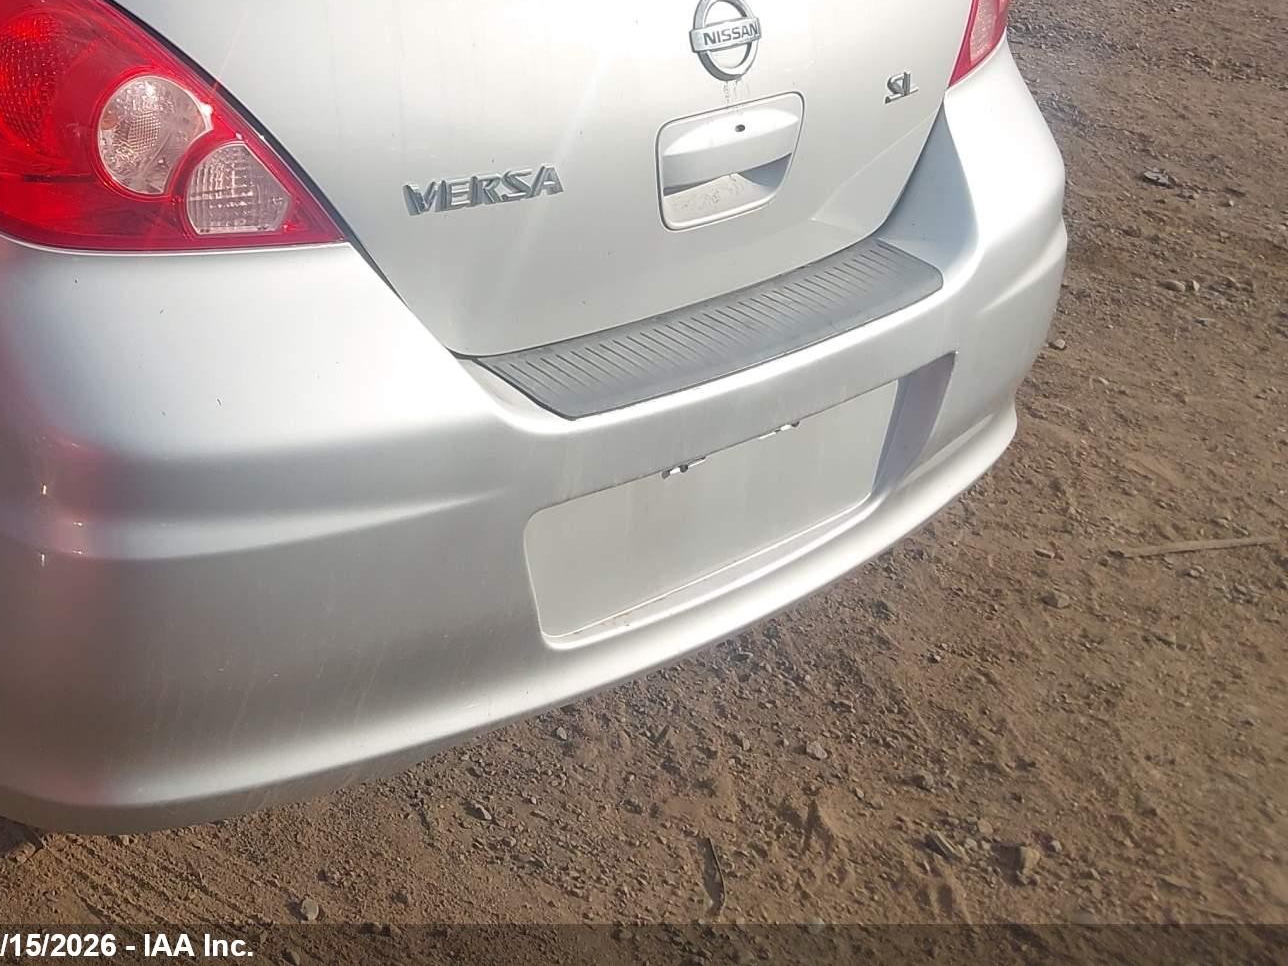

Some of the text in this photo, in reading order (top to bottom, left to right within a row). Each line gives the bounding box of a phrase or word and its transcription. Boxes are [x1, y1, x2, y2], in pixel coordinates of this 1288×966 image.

[703, 22, 760, 46] NISSAN
[884, 71, 920, 105] SL
[403, 163, 564, 216] VERSA
